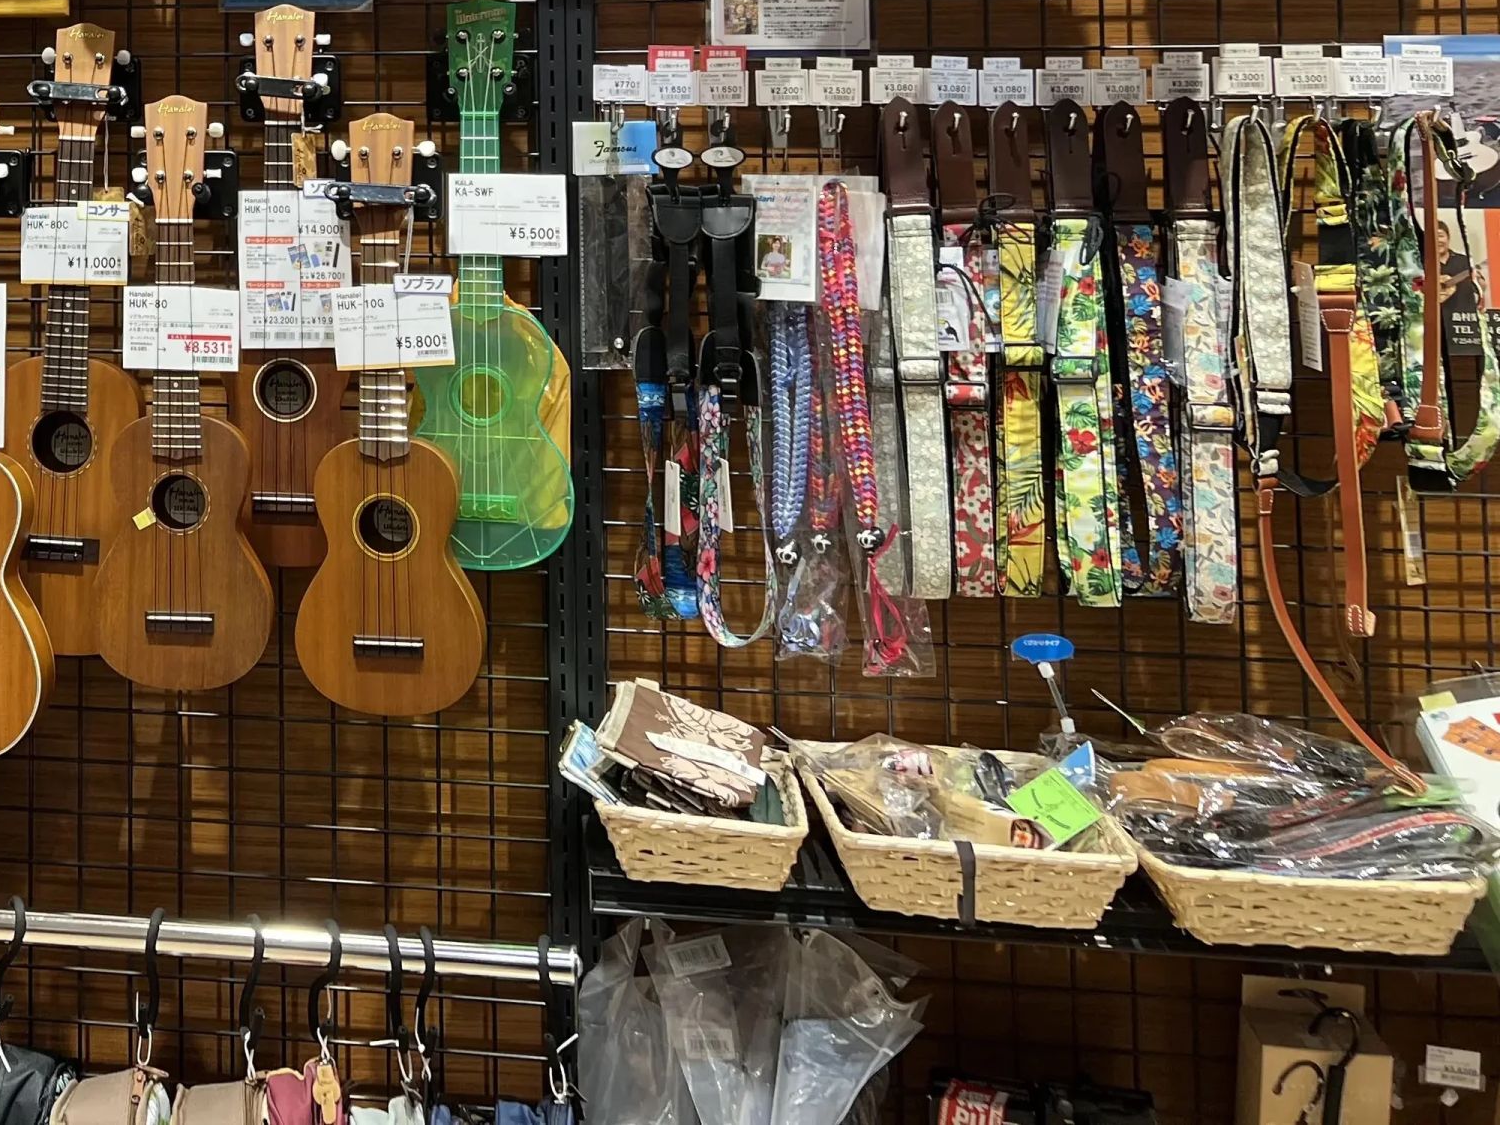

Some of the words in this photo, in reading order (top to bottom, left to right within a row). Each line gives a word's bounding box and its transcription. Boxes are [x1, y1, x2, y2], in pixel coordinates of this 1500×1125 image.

[266, 11, 304, 24] Hanalei
[157, 103, 196, 115] Hanalei
[594, 140, 637, 157] Famous
[455, 187, 494, 197] KA-SWF
[244, 205, 291, 214] HUK-100G
[27, 220, 69, 230] HUK-80C
[298, 224, 339, 235] ¥14,900
[509, 227, 554, 240] ¥5,500
[67, 257, 116, 269] ¥11,000
[402, 277, 444, 290] ソプラノ
[128, 299, 168, 309] HUK-80
[337, 299, 385, 310] HUK-10G
[395, 334, 441, 349] ¥5,800
[184, 341, 225, 355] ¥8,531
